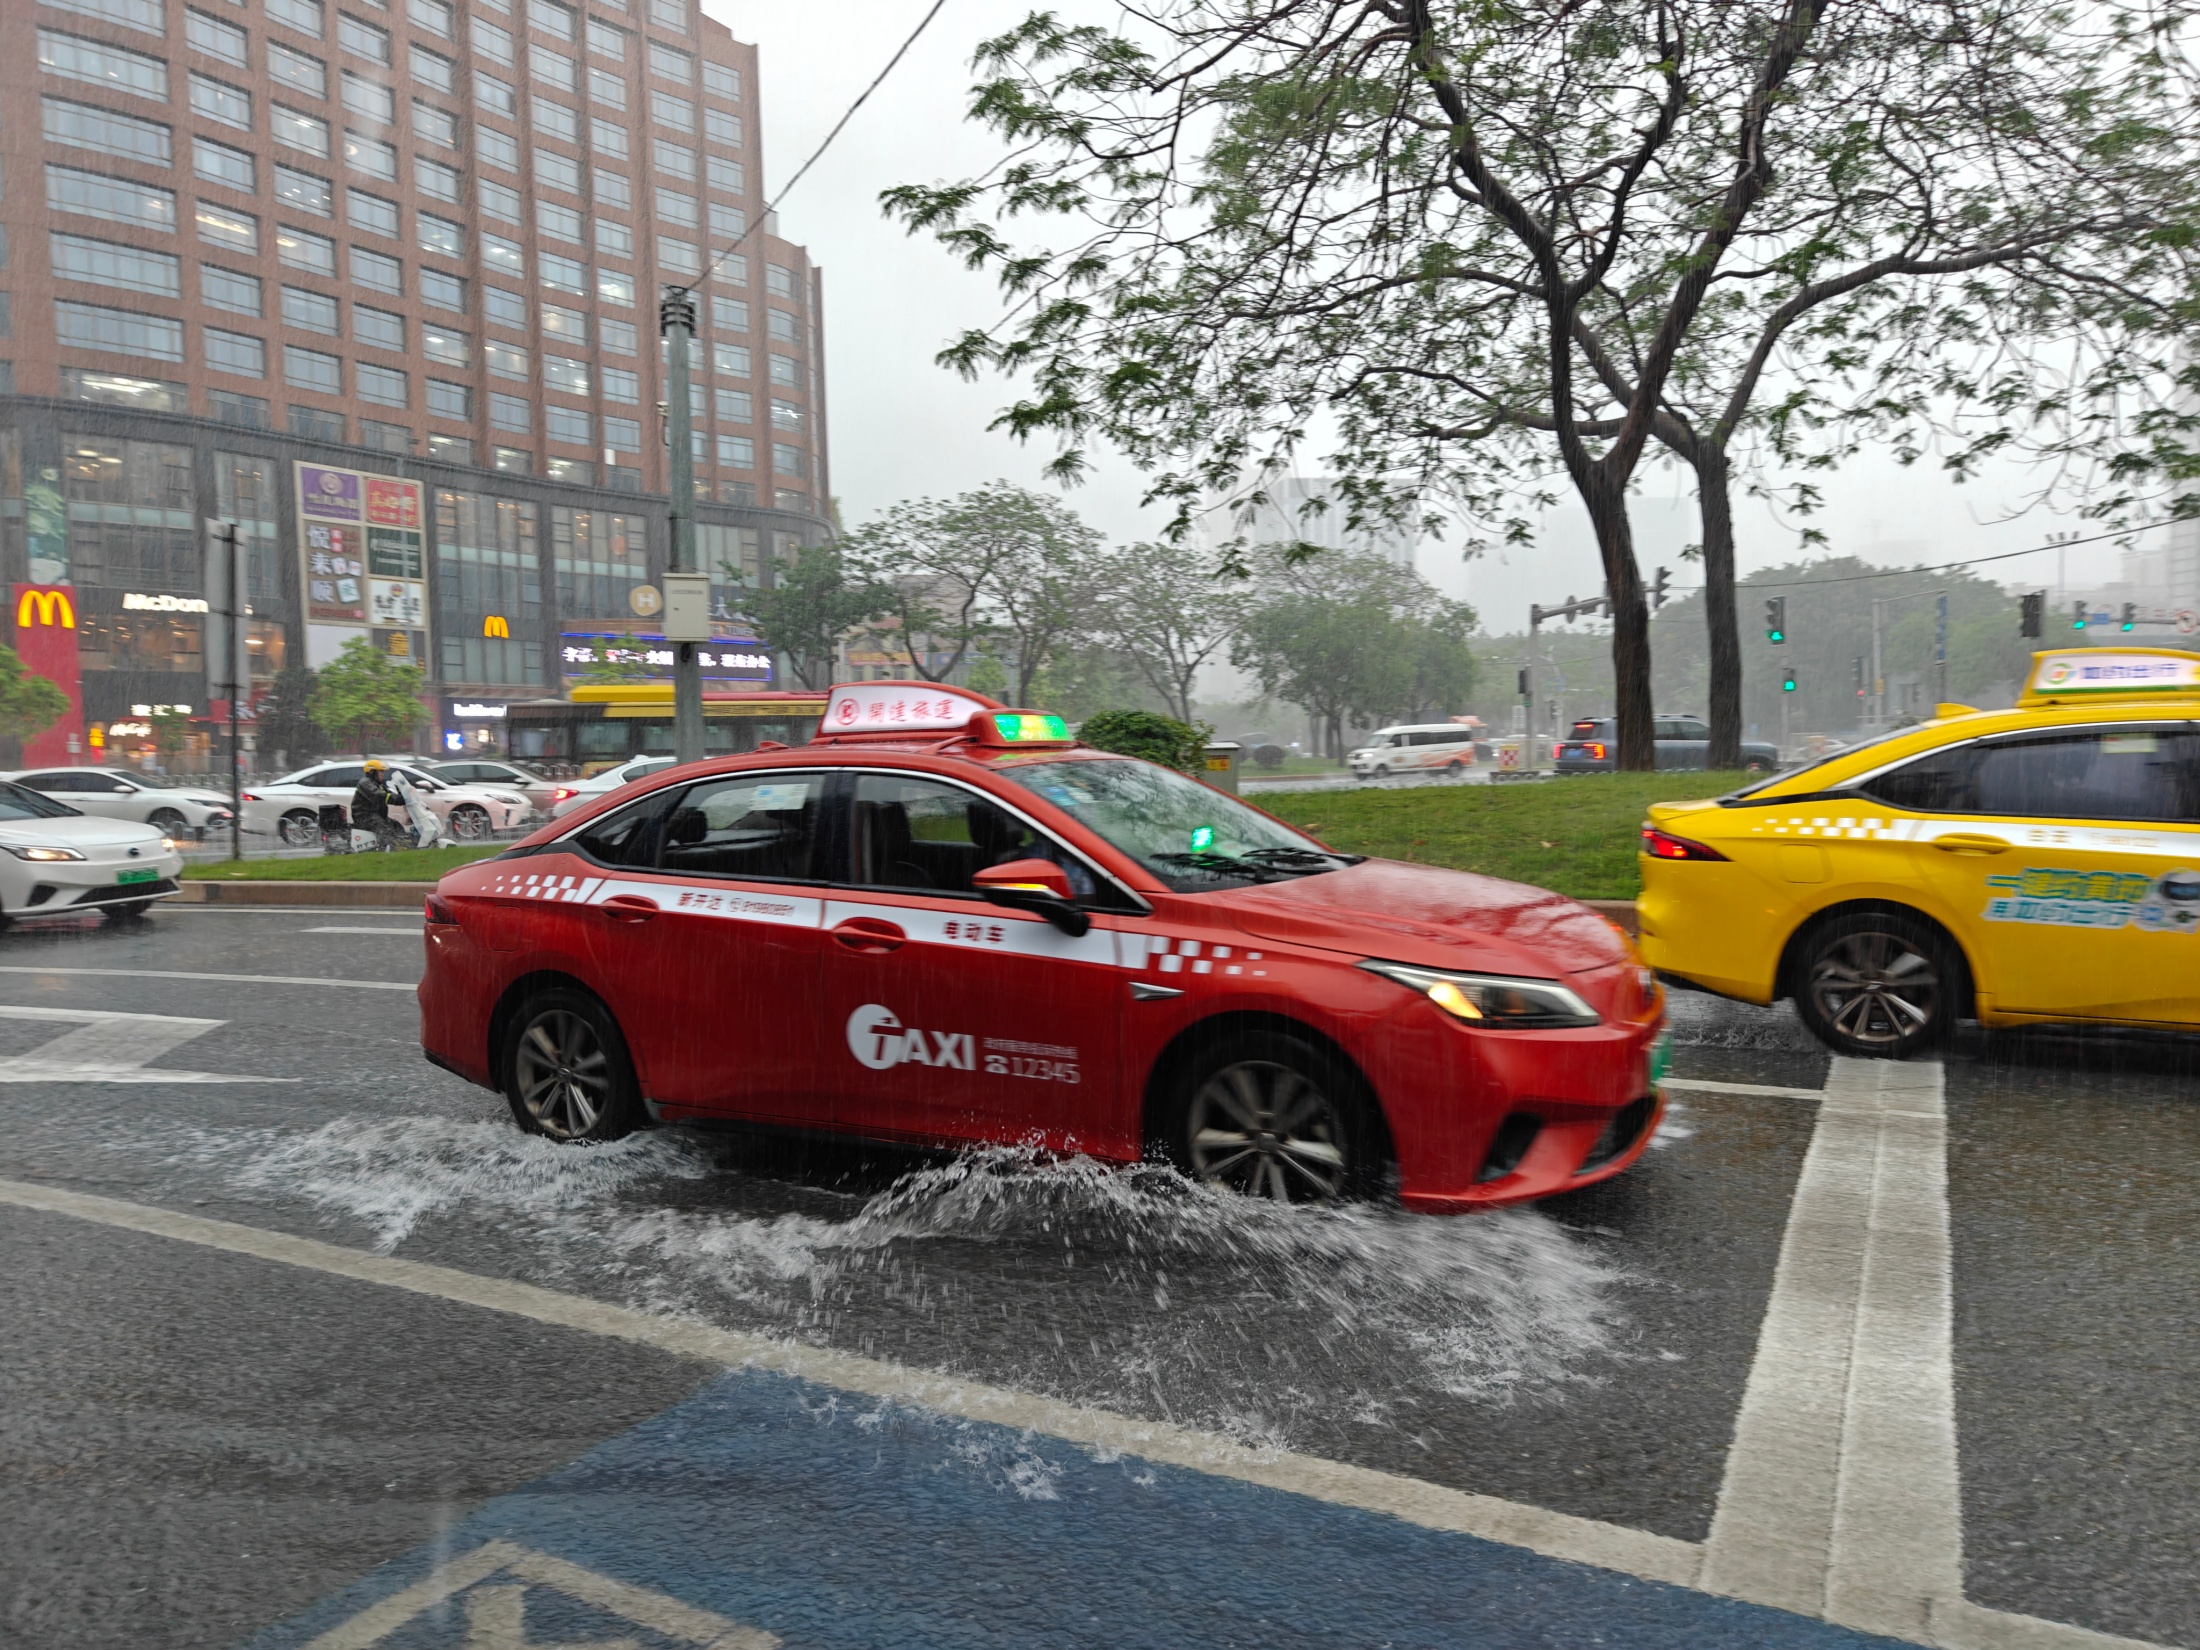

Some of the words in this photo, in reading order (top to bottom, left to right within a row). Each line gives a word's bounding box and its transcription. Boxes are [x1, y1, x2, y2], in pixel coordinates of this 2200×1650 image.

[867, 699, 954, 724] 開達旅運
[943, 920, 1006, 944] 电动车
[856, 1010, 977, 1072] TAXI
[1010, 1056, 1082, 1085] 12345
